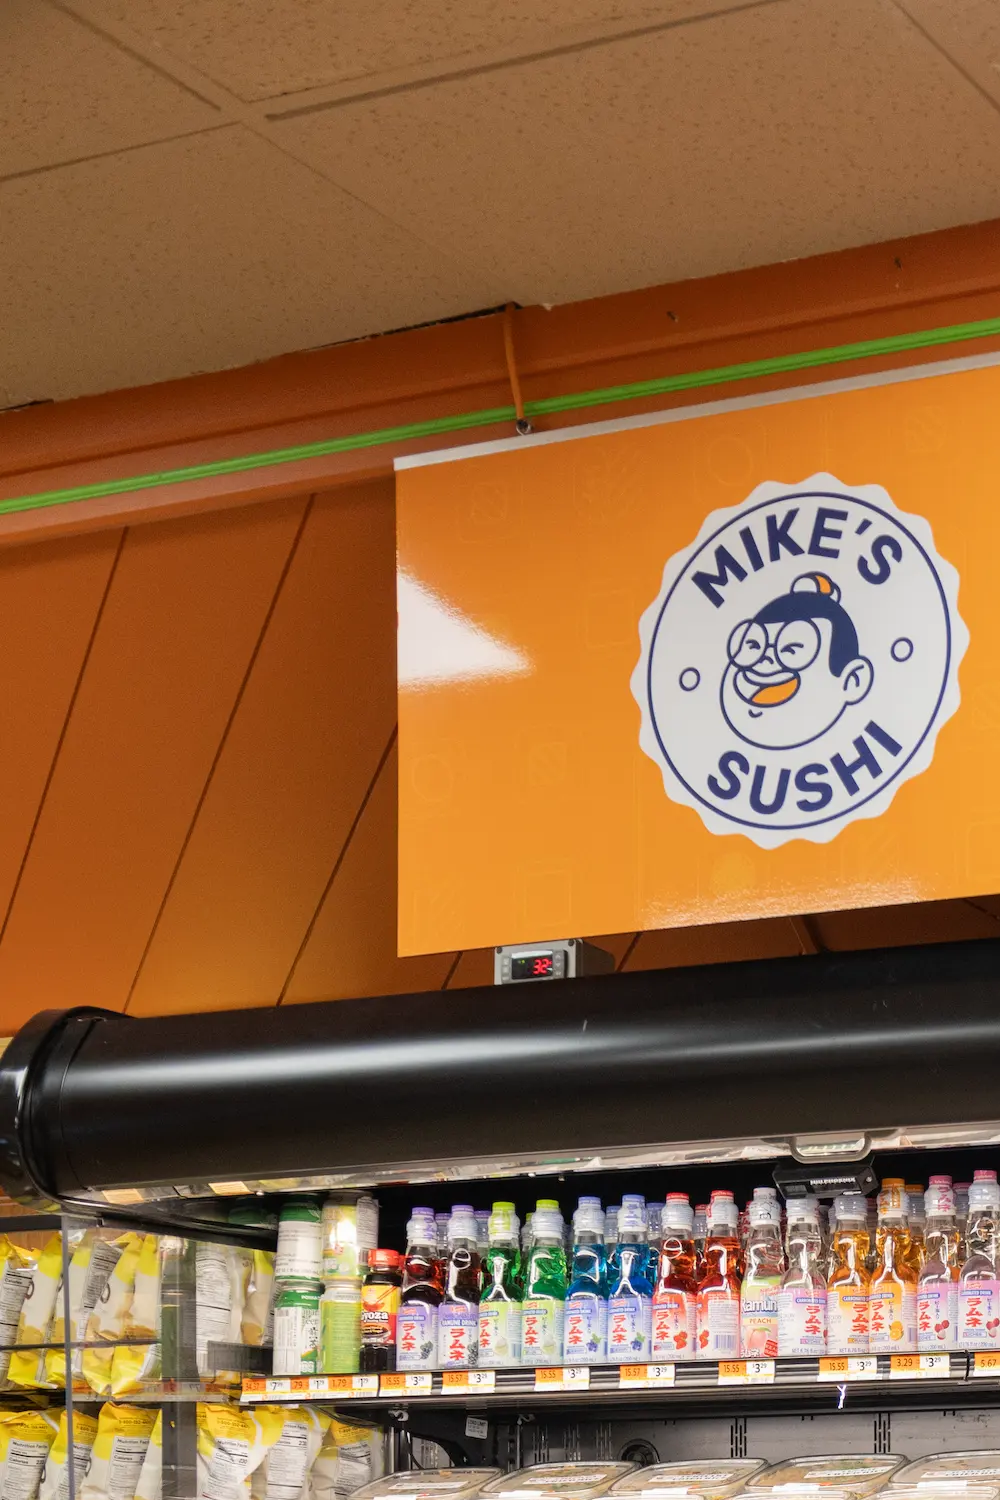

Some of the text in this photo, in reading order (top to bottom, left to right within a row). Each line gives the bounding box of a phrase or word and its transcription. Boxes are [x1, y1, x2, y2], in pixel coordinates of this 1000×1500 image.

[692, 506, 903, 608] MIKE'S
[707, 720, 903, 815] SUSHI
[361, 1311, 389, 1320] yoza
[655, 1311, 670, 1340] ラムネ
[804, 1305, 822, 1335] ラムネ
[871, 1300, 885, 1332] ラムネ
[918, 1300, 932, 1332] ラムネ
[965, 1297, 983, 1328] ラムネ
[401, 1322, 417, 1351] ラムネ
[524, 1316, 539, 1345] ラムネ
[568, 1316, 583, 1345] ラムネ
[612, 1314, 627, 1343] ラムネ
[449, 1328, 466, 1360] ラムネ
[896, 1358, 913, 1367] 3.29
[980, 1359, 997, 1368] 5.67
